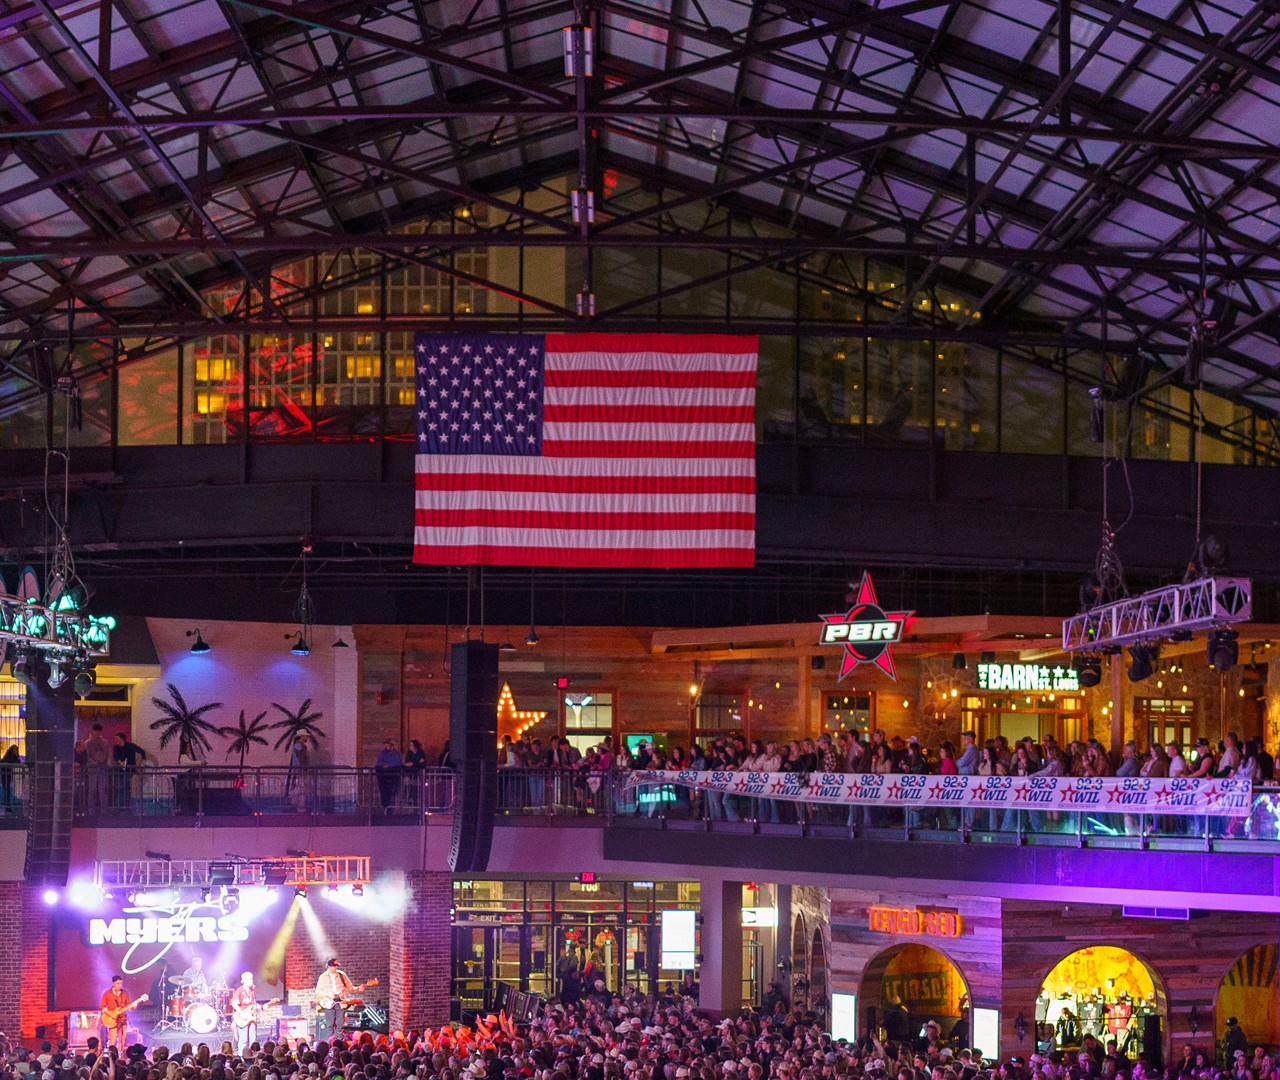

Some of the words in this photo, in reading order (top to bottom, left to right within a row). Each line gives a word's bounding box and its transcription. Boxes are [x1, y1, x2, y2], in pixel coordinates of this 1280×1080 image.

[825, 622, 897, 642] PBR
[988, 664, 1039, 690] BARN
[1053, 678, 1079, 690] LOUIS
[820, 786, 842, 797] WIL
[859, 788, 882, 798] WIL
[899, 788, 923, 799] WIL
[941, 789, 965, 799] WIL
[983, 789, 1008, 800] WIL
[1028, 790, 1053, 802] WIL
[1074, 791, 1100, 803] WIL
[1121, 792, 1147, 804] WIL
[1170, 793, 1197, 805] WIL
[870, 908, 920, 935] TENGO
[925, 911, 960, 937] SED
[89, 916, 249, 945] MYERS
